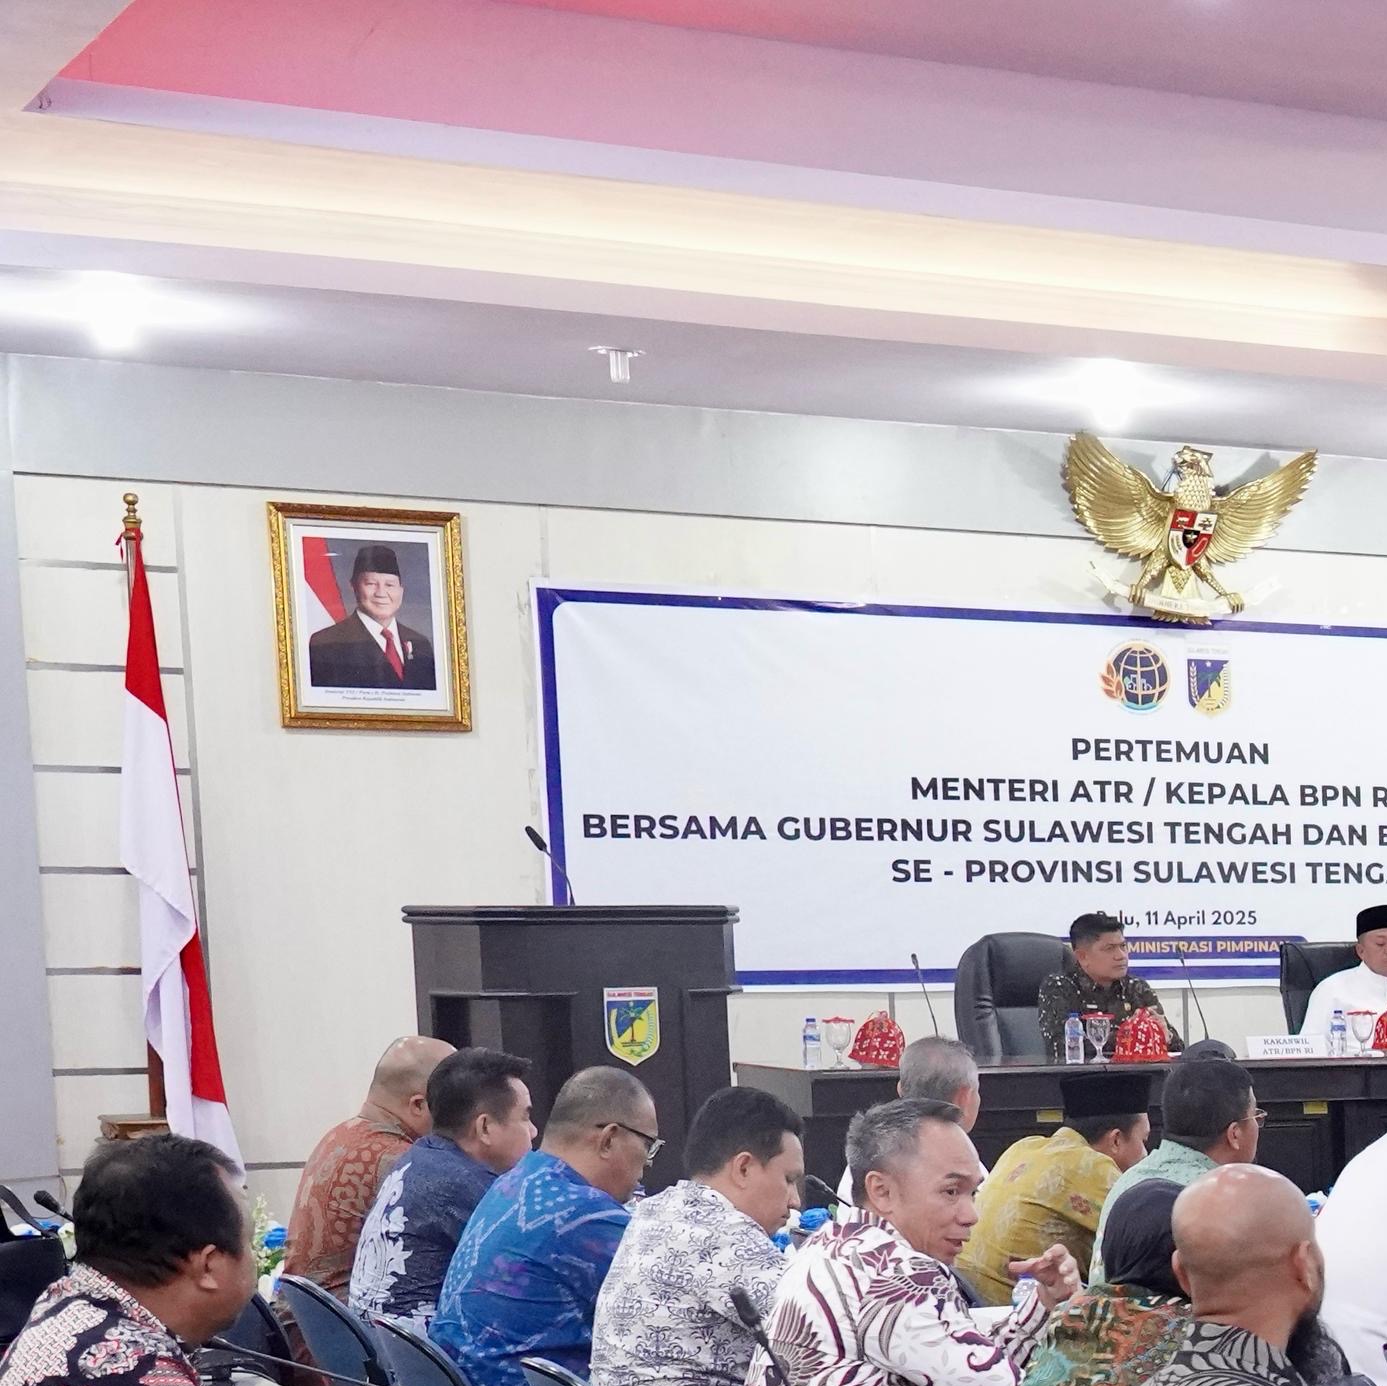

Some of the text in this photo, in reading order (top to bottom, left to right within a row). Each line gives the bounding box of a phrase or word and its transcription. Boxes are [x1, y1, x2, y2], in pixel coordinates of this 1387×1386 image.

[1072, 738, 1269, 765] PERTEMUAN
[912, 777, 1058, 802] MENTERI
[1070, 780, 1133, 803] ATR
[1143, 777, 1155, 806] /
[1166, 781, 1290, 806] KEPALA
[1300, 785, 1362, 807] BPN
[583, 813, 766, 840] BERSAMA
[777, 816, 972, 843] GUBERNUR
[983, 819, 1153, 844] SULAWESI
[1164, 822, 1291, 845] TENGAH
[1303, 824, 1367, 846] DAN
[892, 858, 932, 882] SE
[966, 859, 1122, 884] PROVINSI
[1134, 861, 1295, 884] SULAWESI
[1097, 909, 1257, 929] lu, 11 April 2025
[1125, 940, 1289, 953] MINISTRASI PIMPINA
[1262, 1047, 1314, 1056] ATR/BPN RI
[1263, 1038, 1310, 1046] KAKANWIL
